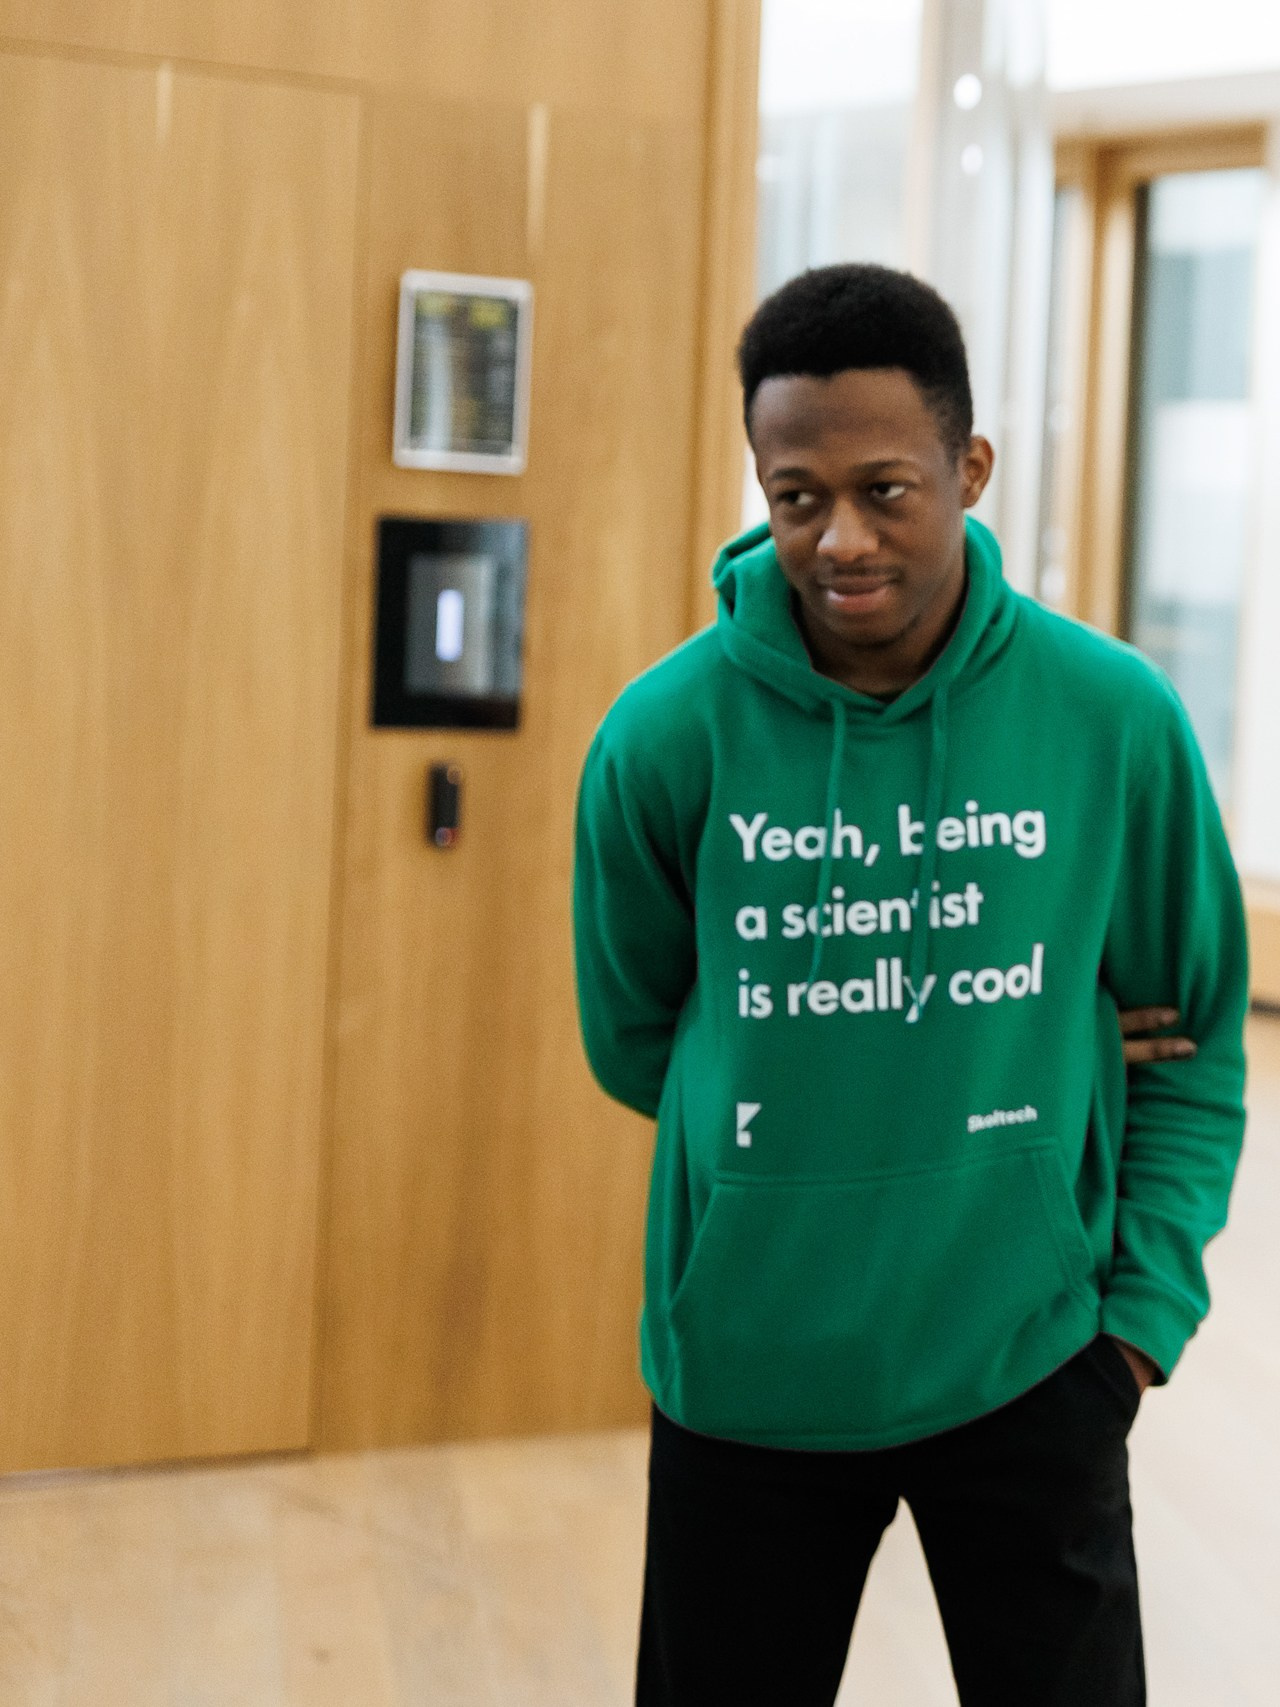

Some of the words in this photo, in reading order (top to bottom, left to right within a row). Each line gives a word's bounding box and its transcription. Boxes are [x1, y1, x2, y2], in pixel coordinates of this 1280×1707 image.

[729, 809, 880, 867] Yeah,
[898, 800, 1047, 859] being
[735, 905, 768, 940] a
[781, 880, 984, 939] scienist
[738, 967, 773, 1019] is
[787, 956, 937, 1023] really
[948, 942, 1045, 1006] cool
